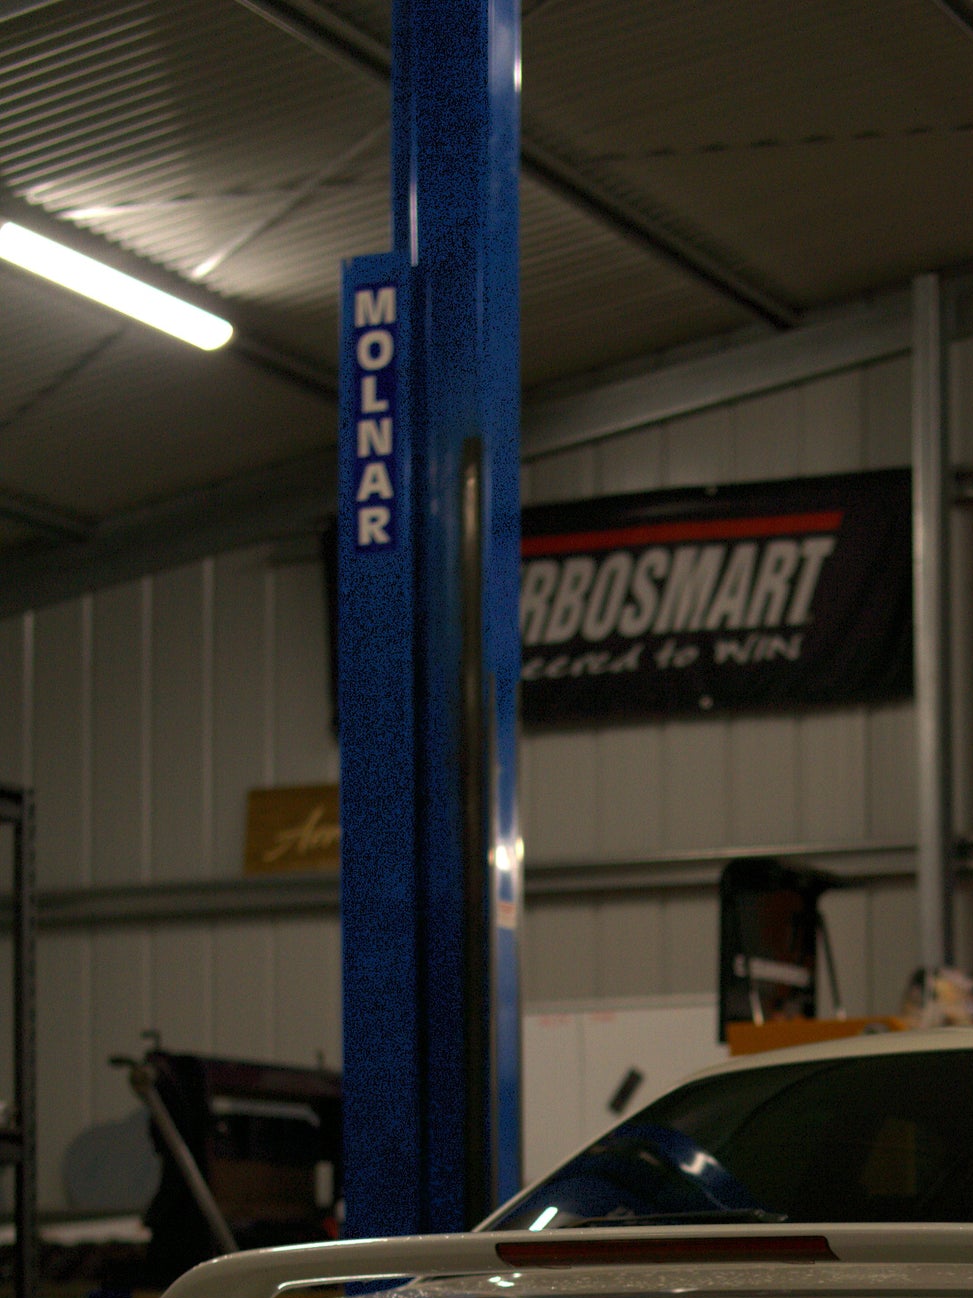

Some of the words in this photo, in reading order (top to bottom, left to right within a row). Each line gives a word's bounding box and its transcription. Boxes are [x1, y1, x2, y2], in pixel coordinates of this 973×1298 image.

[354, 286, 396, 547] MOLNAR
[655, 638, 700, 670] to
[713, 633, 803, 665] WIN
